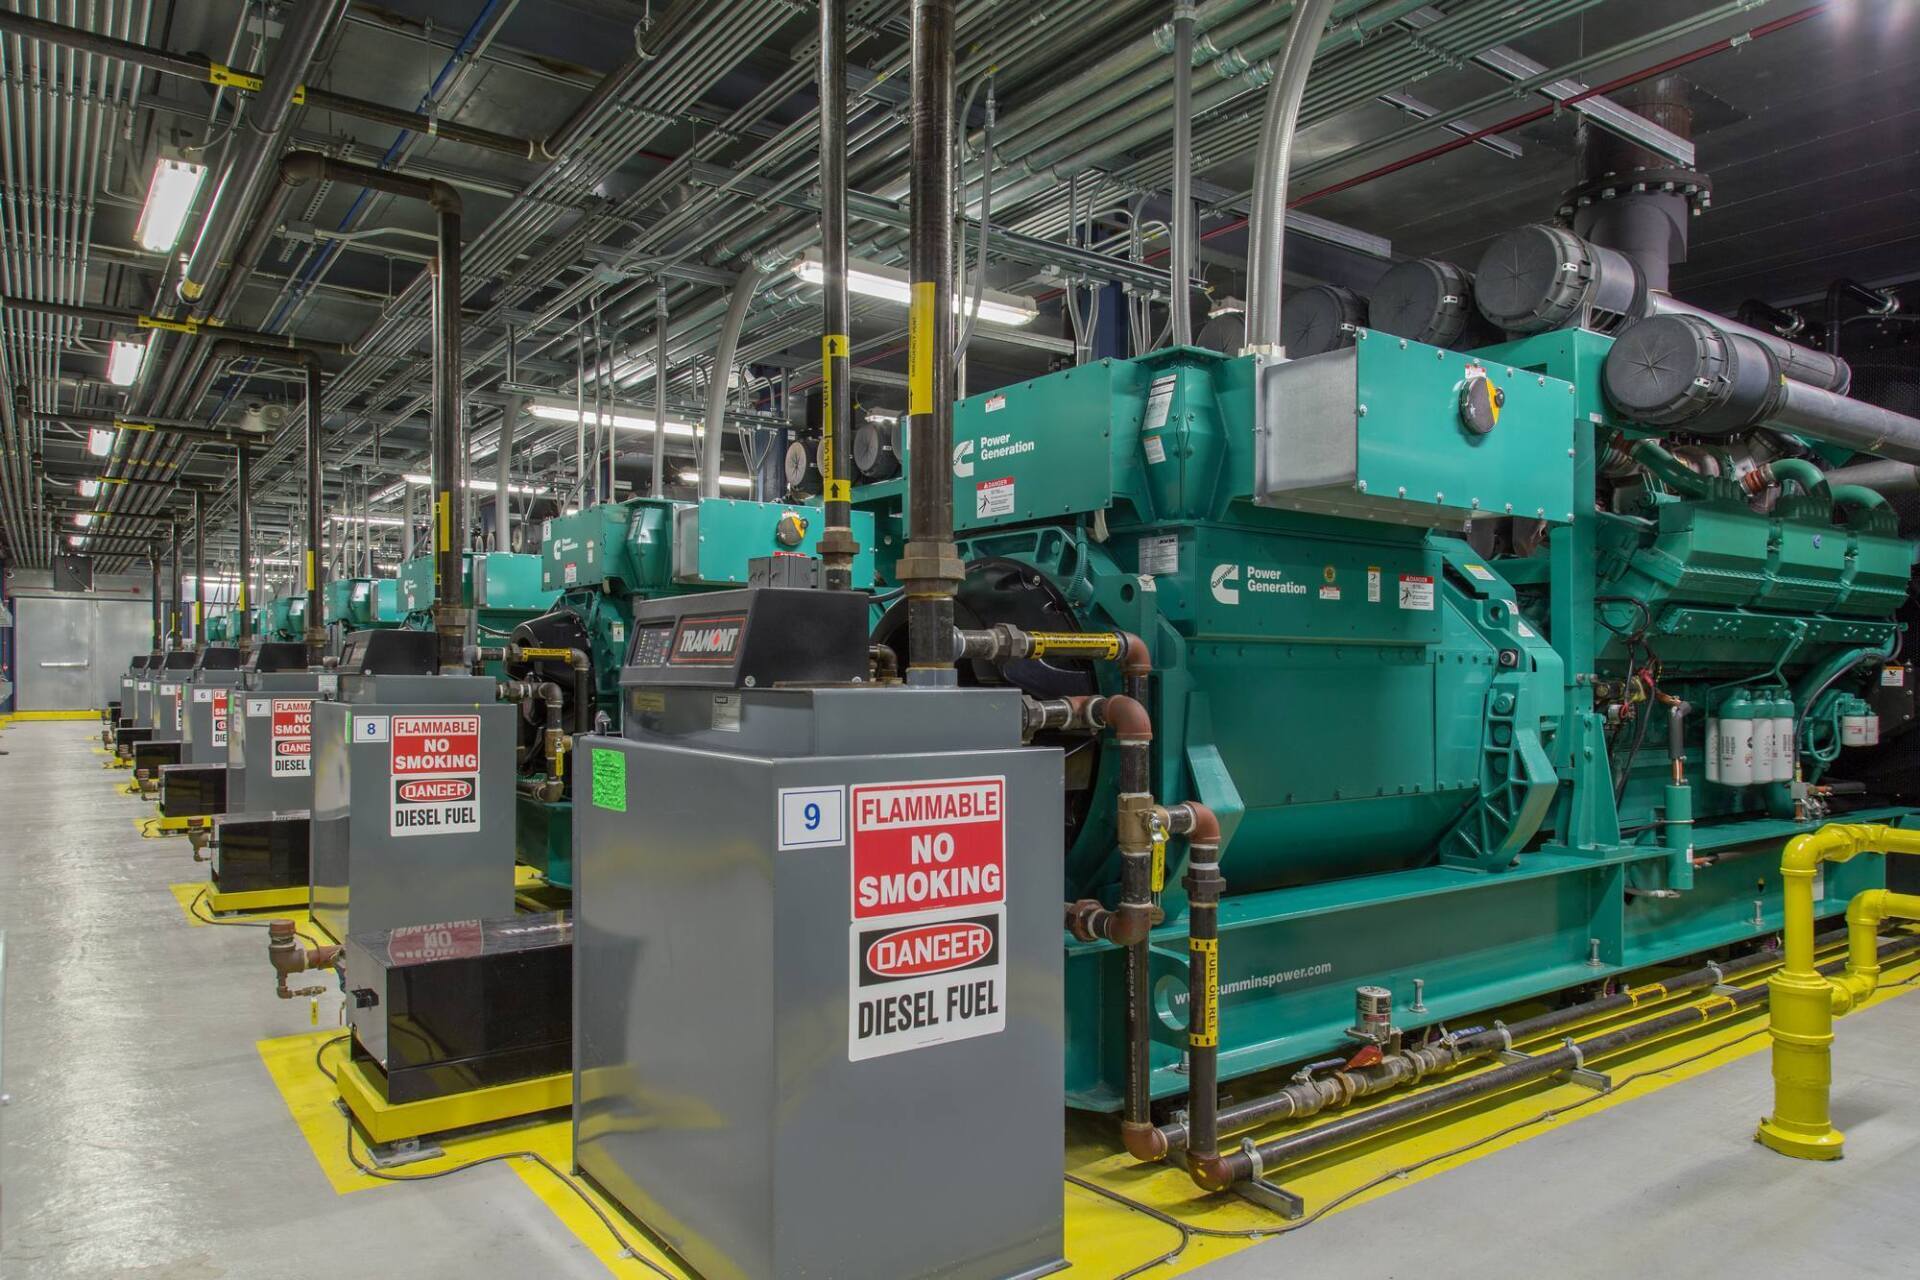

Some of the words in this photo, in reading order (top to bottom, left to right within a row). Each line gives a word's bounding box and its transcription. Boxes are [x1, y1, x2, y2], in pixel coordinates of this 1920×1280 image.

[980, 434, 1010, 448] Power
[981, 441, 1034, 461] Generation
[1247, 566, 1281, 580] Power
[1247, 580, 1307, 594] Generation
[680, 628, 739, 652] TRAMONT
[256, 704, 262, 712] 7
[294, 714, 311, 724] NO
[274, 725, 311, 734] SMOK
[367, 723, 376, 735] 8
[397, 721, 475, 734] FLAMMABLE
[282, 743, 311, 753] DANG
[424, 738, 450, 753] NO
[275, 760, 306, 771] DIESEL
[395, 754, 477, 770] SMOKING
[405, 783, 467, 798] DANGER
[861, 791, 997, 825] FLAMMABLE
[395, 808, 441, 827] DIESEL
[445, 807, 476, 825] FUEL
[804, 803, 821, 830] 9
[911, 832, 955, 865] NO
[859, 863, 1001, 908] SMOKING
[877, 928, 985, 970] DANGER
[1174, 961, 1332, 1006] wumminspower.com
[858, 990, 939, 1040] DIESEL
[946, 979, 998, 1022] FUEL
